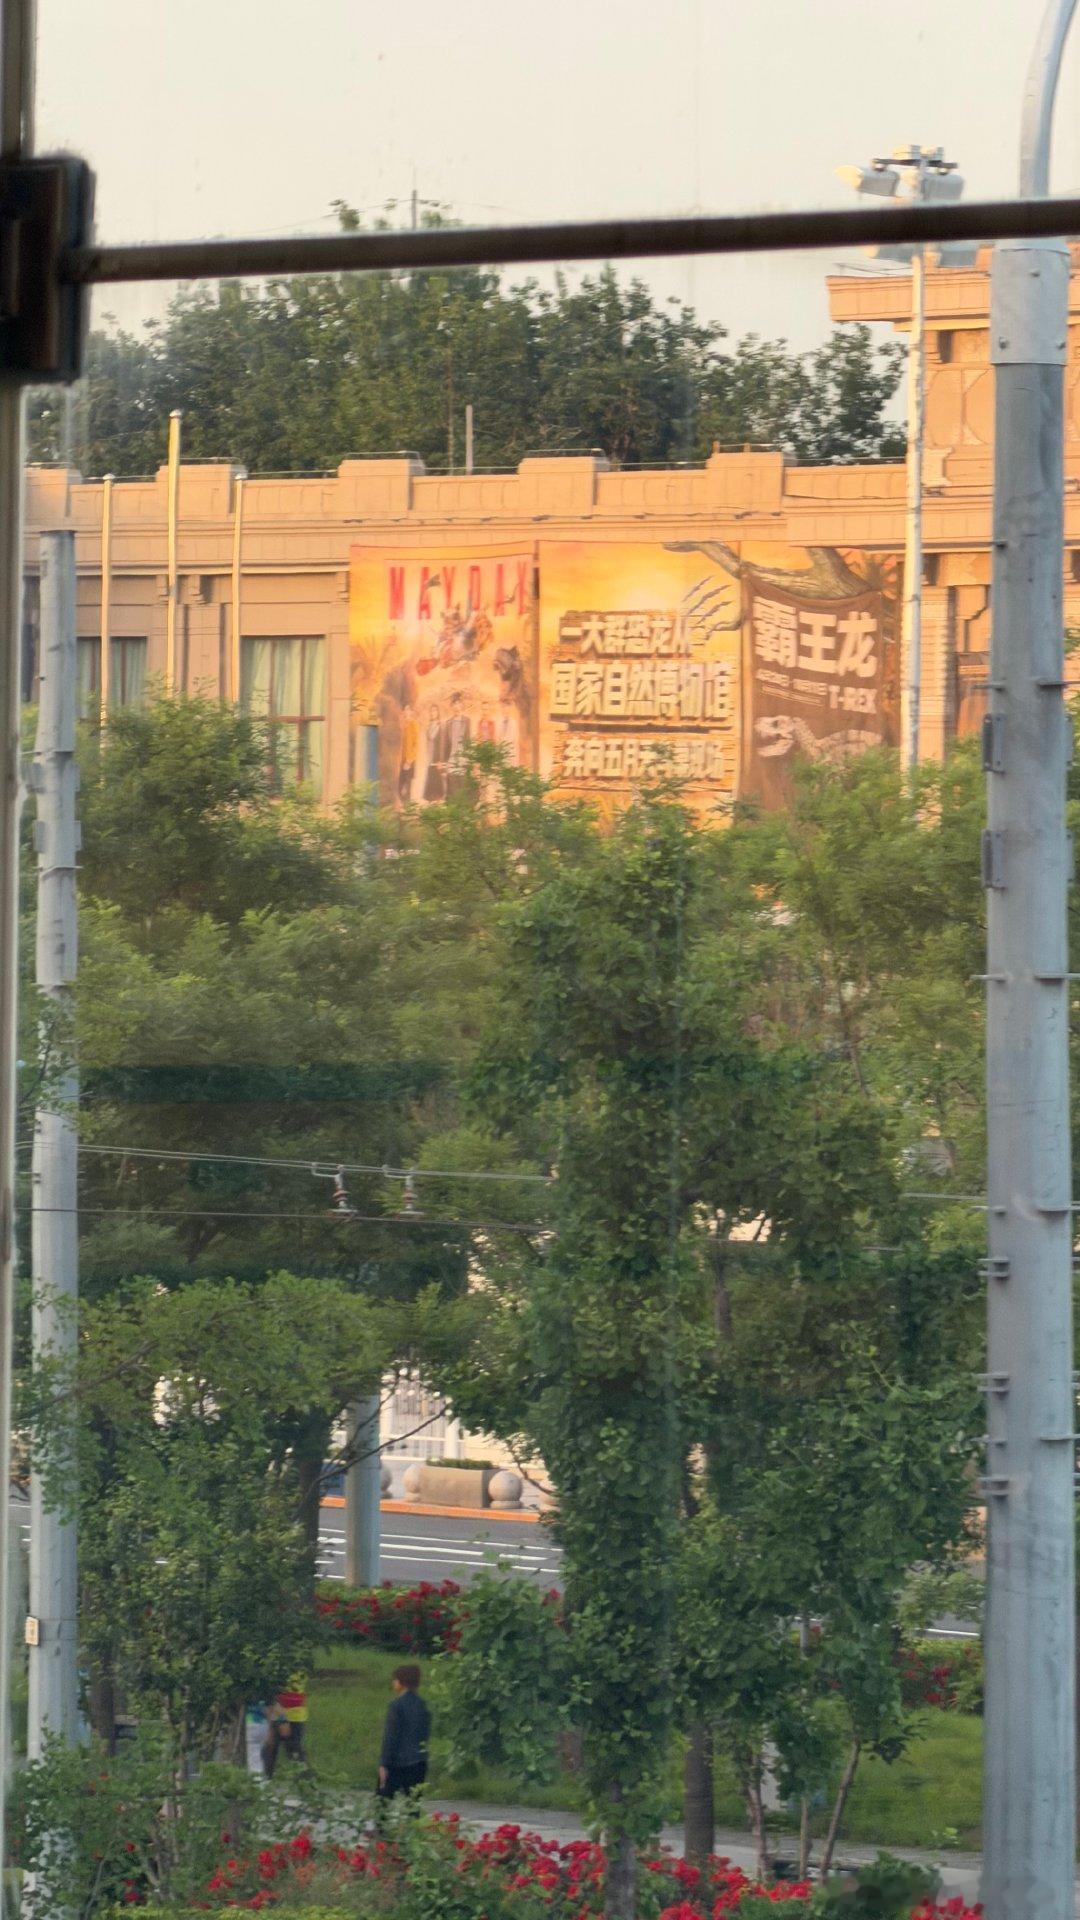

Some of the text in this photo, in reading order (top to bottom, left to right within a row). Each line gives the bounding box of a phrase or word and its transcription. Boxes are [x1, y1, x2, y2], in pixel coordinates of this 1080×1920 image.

[388, 561, 528, 621] MAYDAY
[752, 596, 878, 678] 霸王龙
[551, 659, 729, 719] 国家自然博物馆
